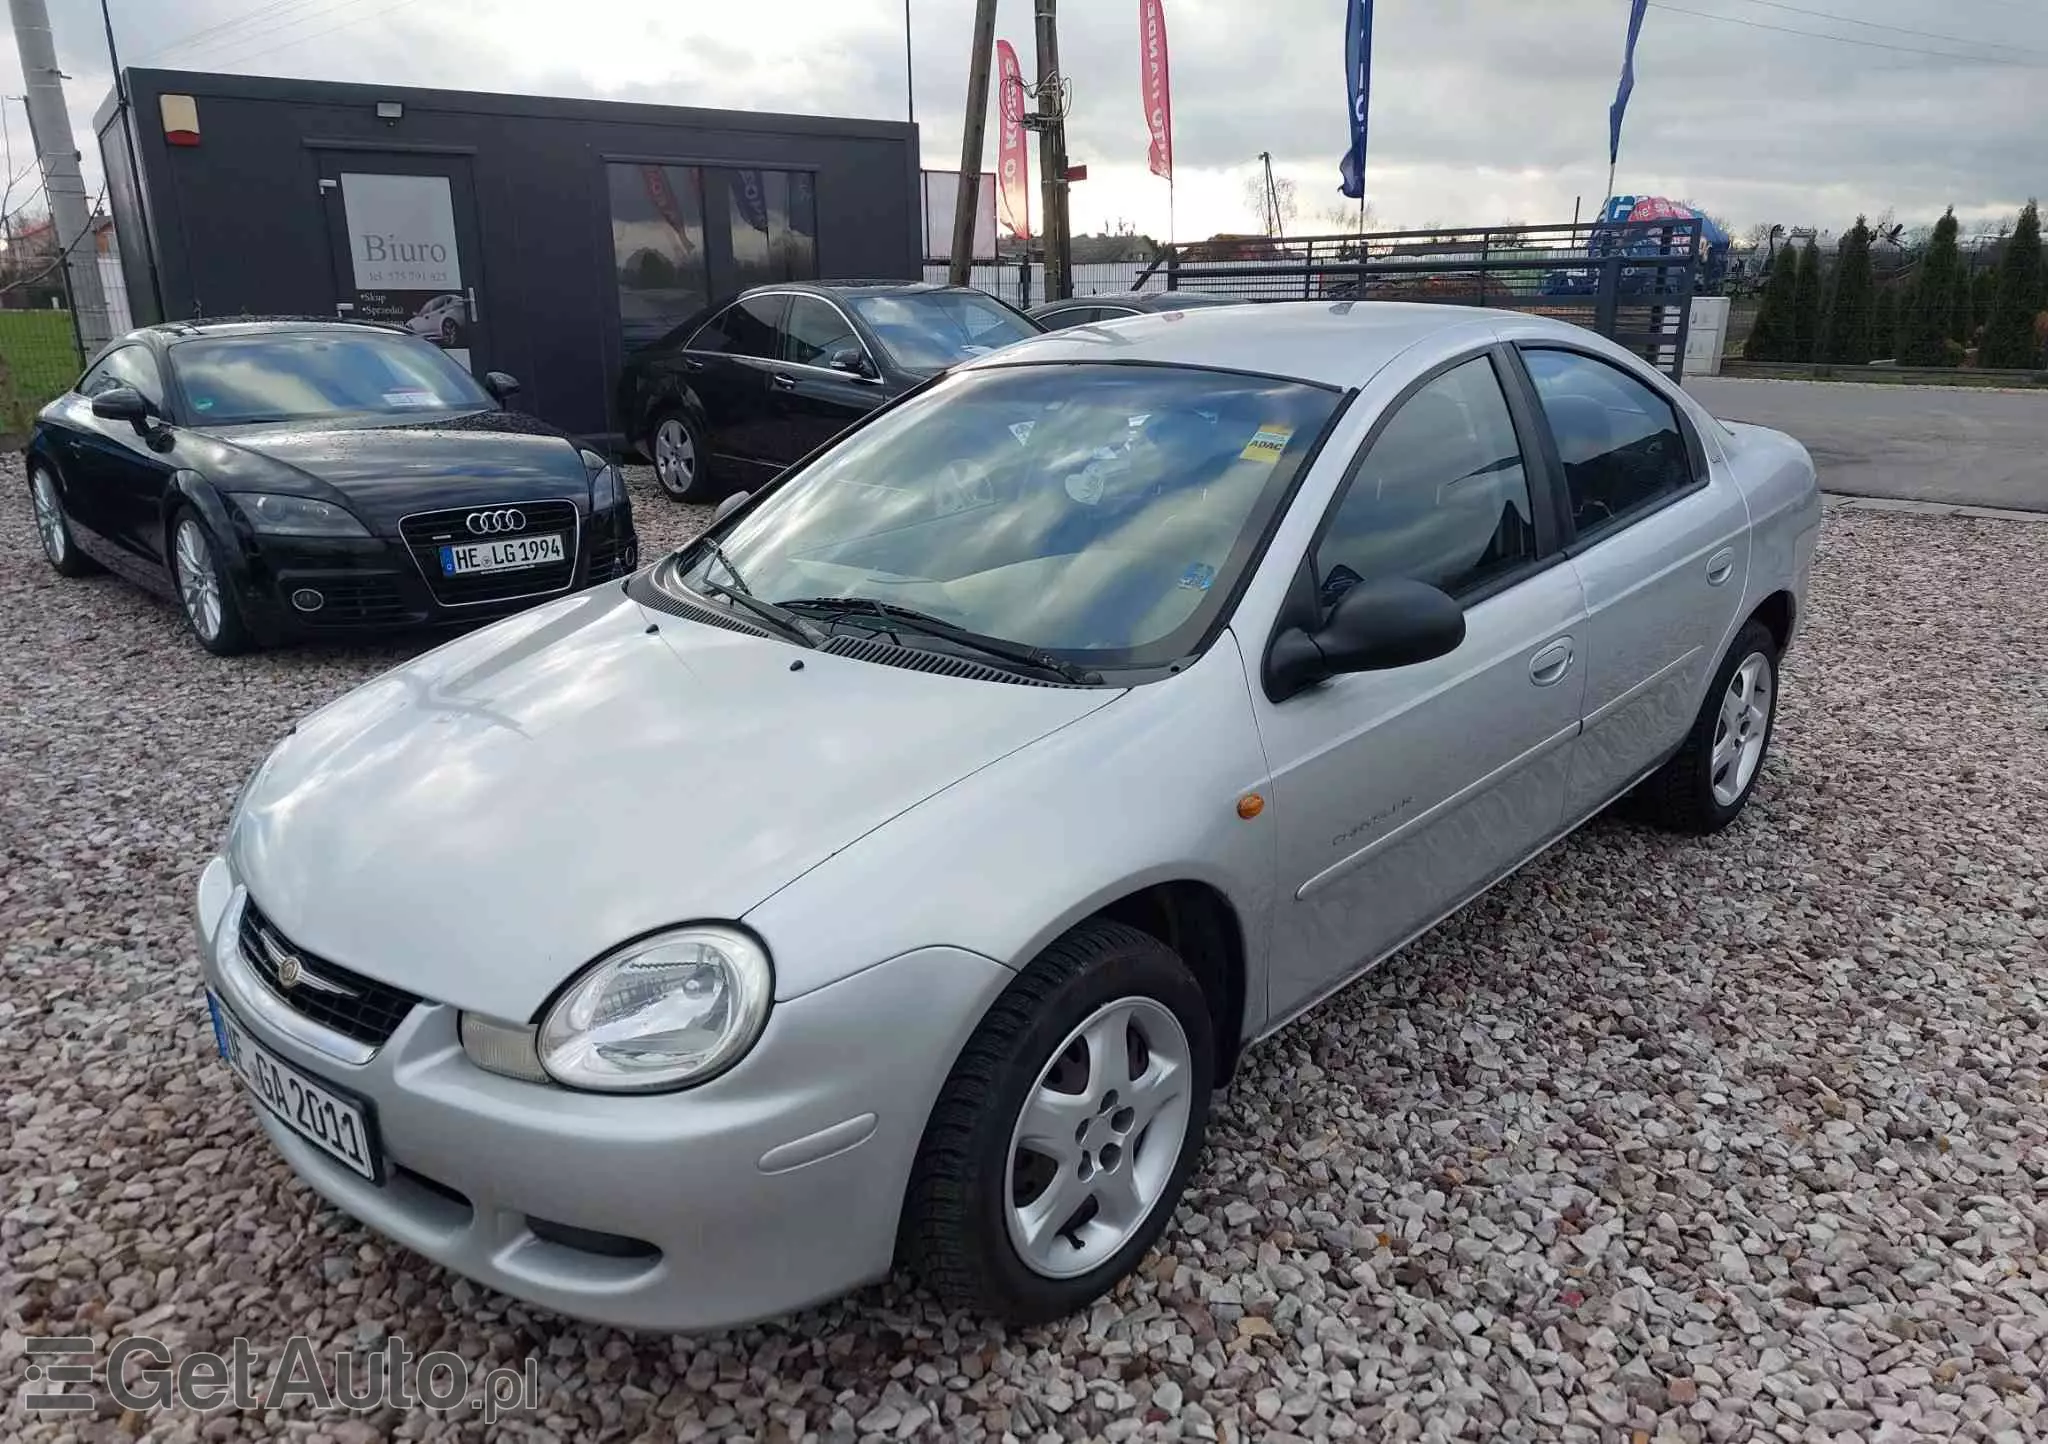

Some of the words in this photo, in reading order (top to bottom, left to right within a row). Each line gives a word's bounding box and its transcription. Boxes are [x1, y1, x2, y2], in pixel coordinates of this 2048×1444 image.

[362, 234, 447, 263] Biuro
[1249, 440, 1283, 450] ADAC
[455, 547, 480, 569] HE
[492, 544, 516, 565] LG
[519, 538, 560, 561] 1994
[255, 1052, 291, 1117] GA
[288, 1078, 365, 1167] 2011
